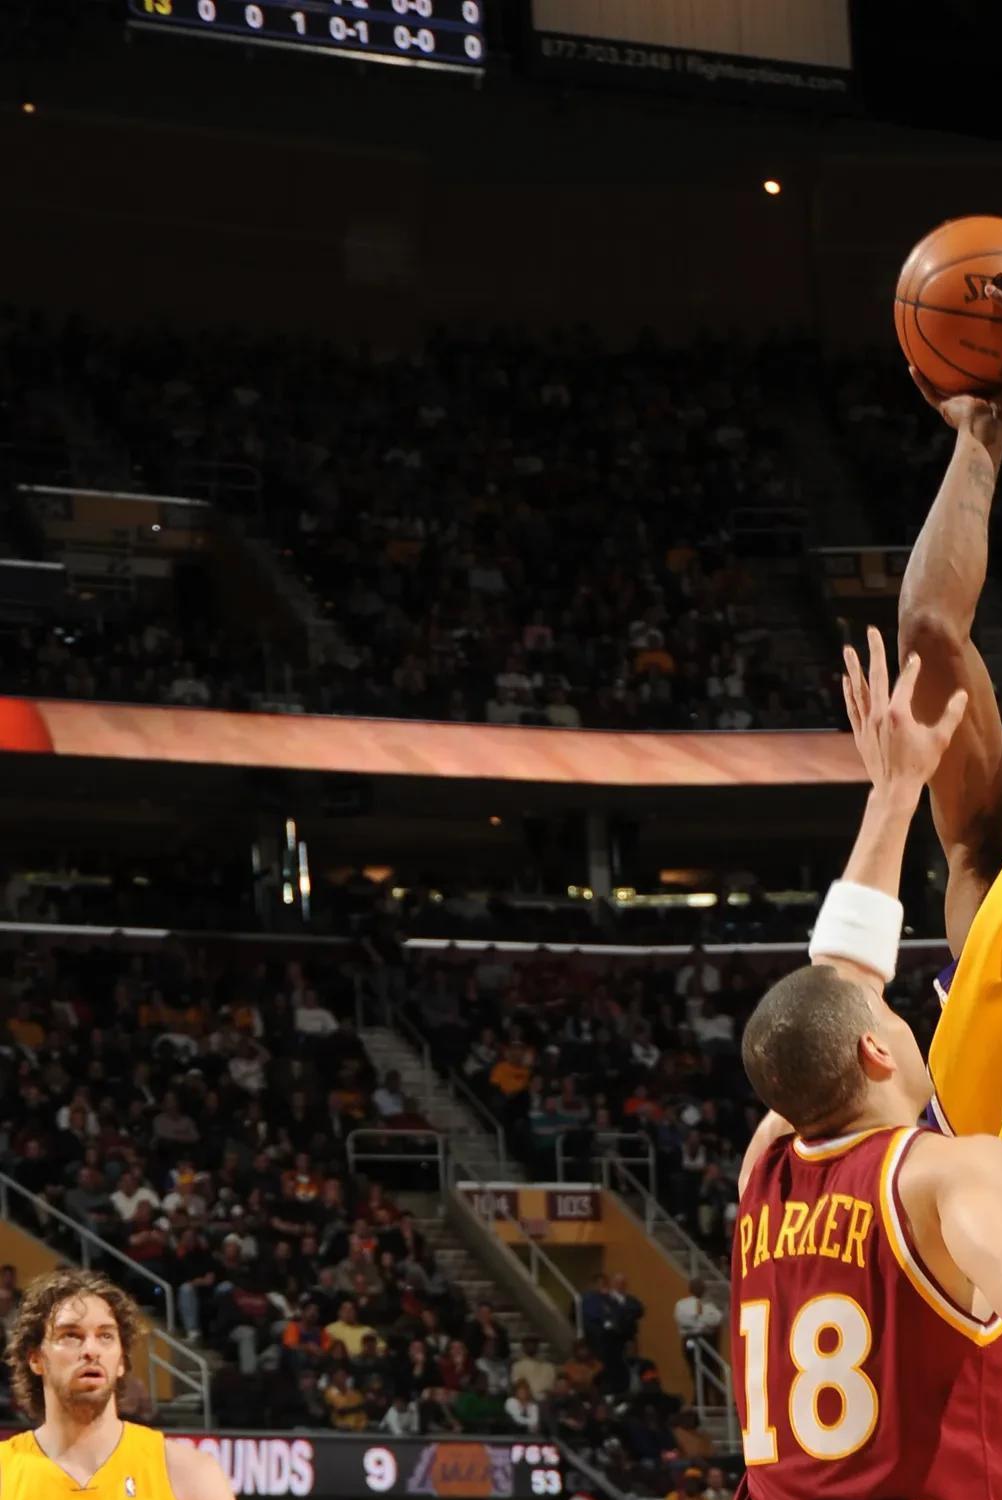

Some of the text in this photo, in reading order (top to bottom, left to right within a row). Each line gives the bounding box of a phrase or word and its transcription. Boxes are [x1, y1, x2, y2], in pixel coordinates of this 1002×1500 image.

[244, 4, 264, 29] 0
[290, 11, 306, 35] 1
[328, 15, 369, 45] 0-1
[393, 24, 436, 54] 0-0
[463, 34, 482, 60] 0
[739, 1192, 874, 1280] PARKER
[739, 1292, 879, 1467] 18
[362, 1446, 398, 1493] 9
[530, 1468, 563, 1496] 53
